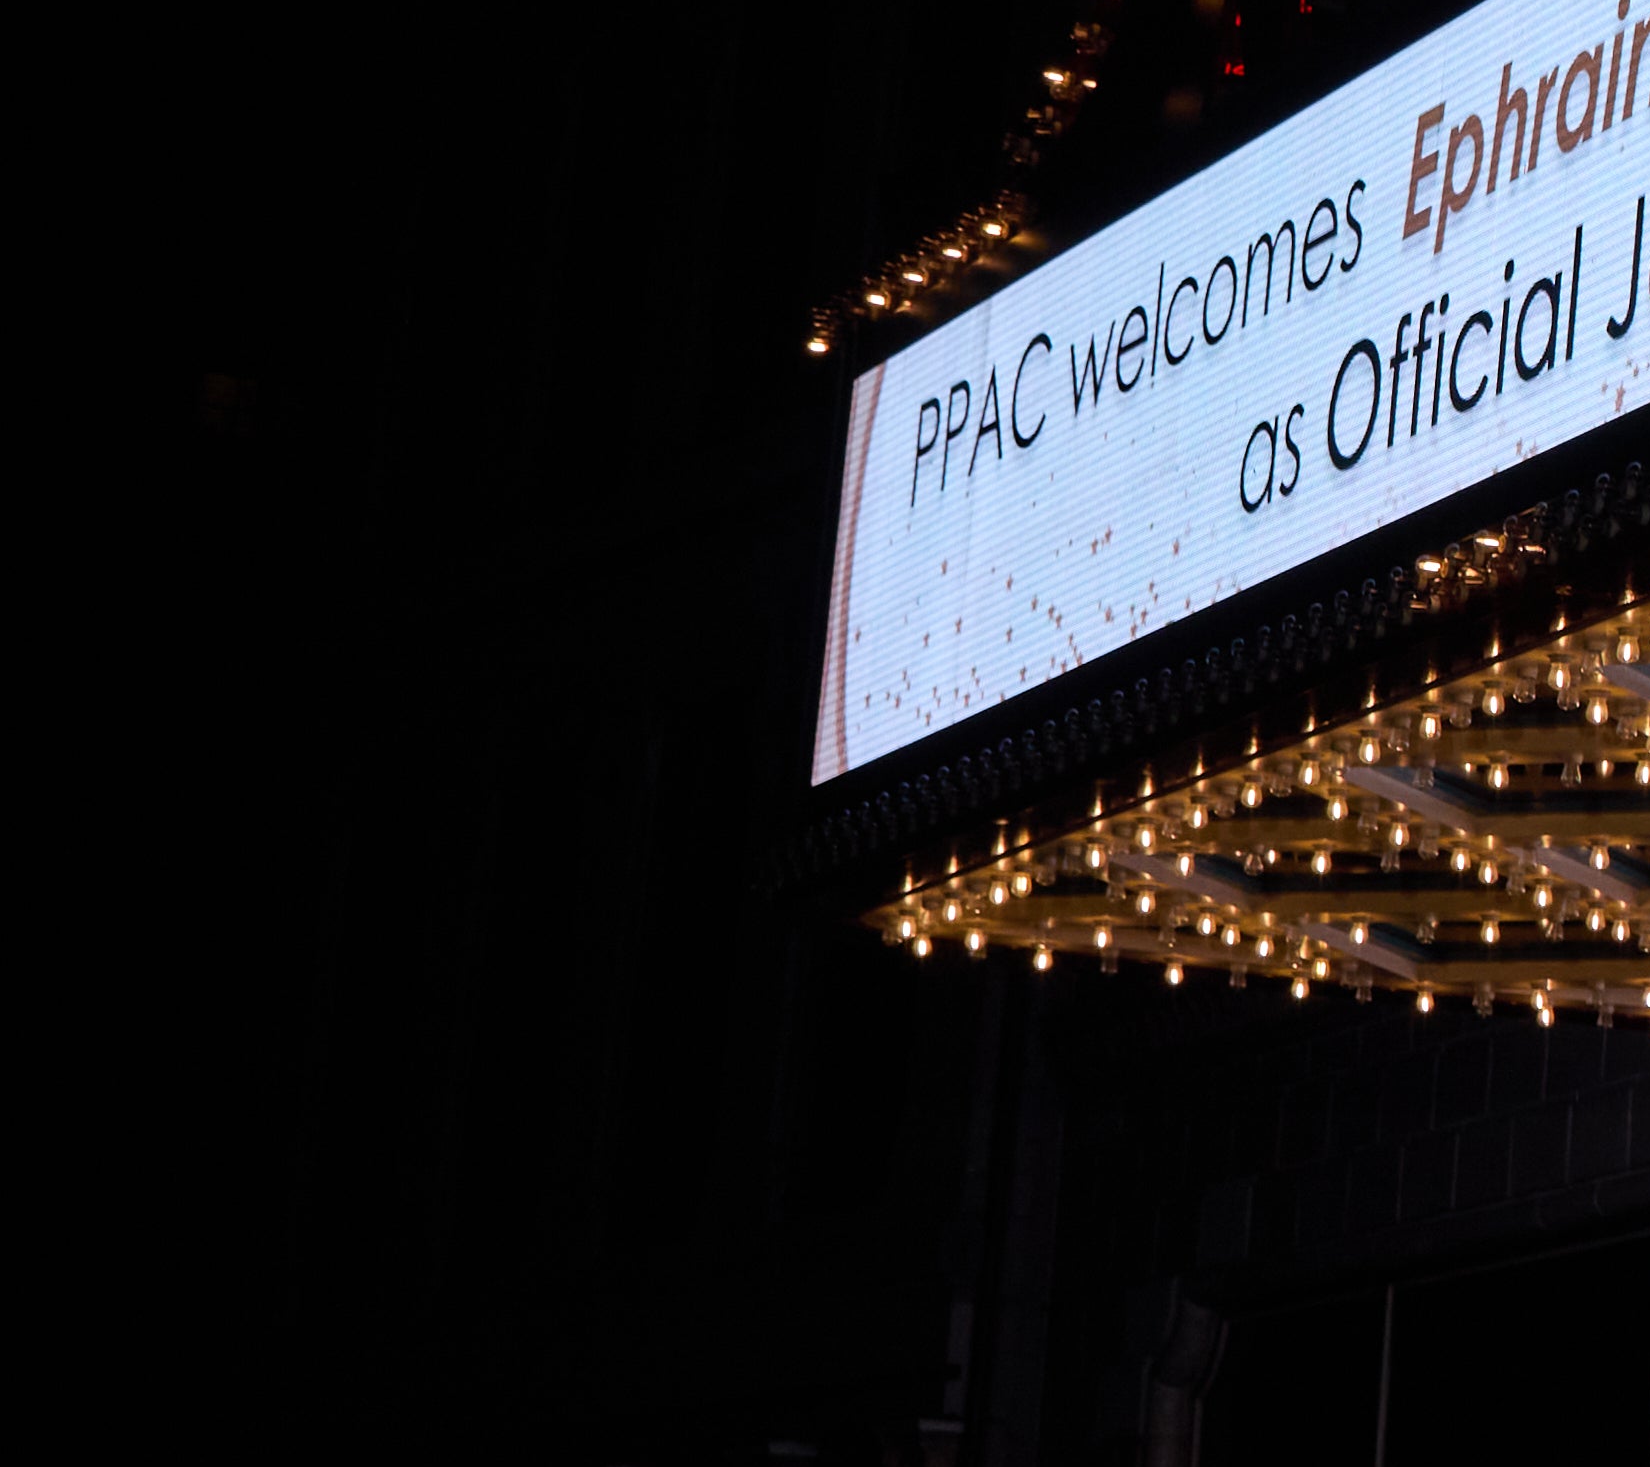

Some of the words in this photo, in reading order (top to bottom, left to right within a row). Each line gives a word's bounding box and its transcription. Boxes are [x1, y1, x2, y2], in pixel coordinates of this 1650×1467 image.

[909, 332, 1056, 507] PPAC
[1069, 178, 1367, 417] welcomes
[1239, 403, 1305, 513] as
[1326, 224, 1584, 471] Official
